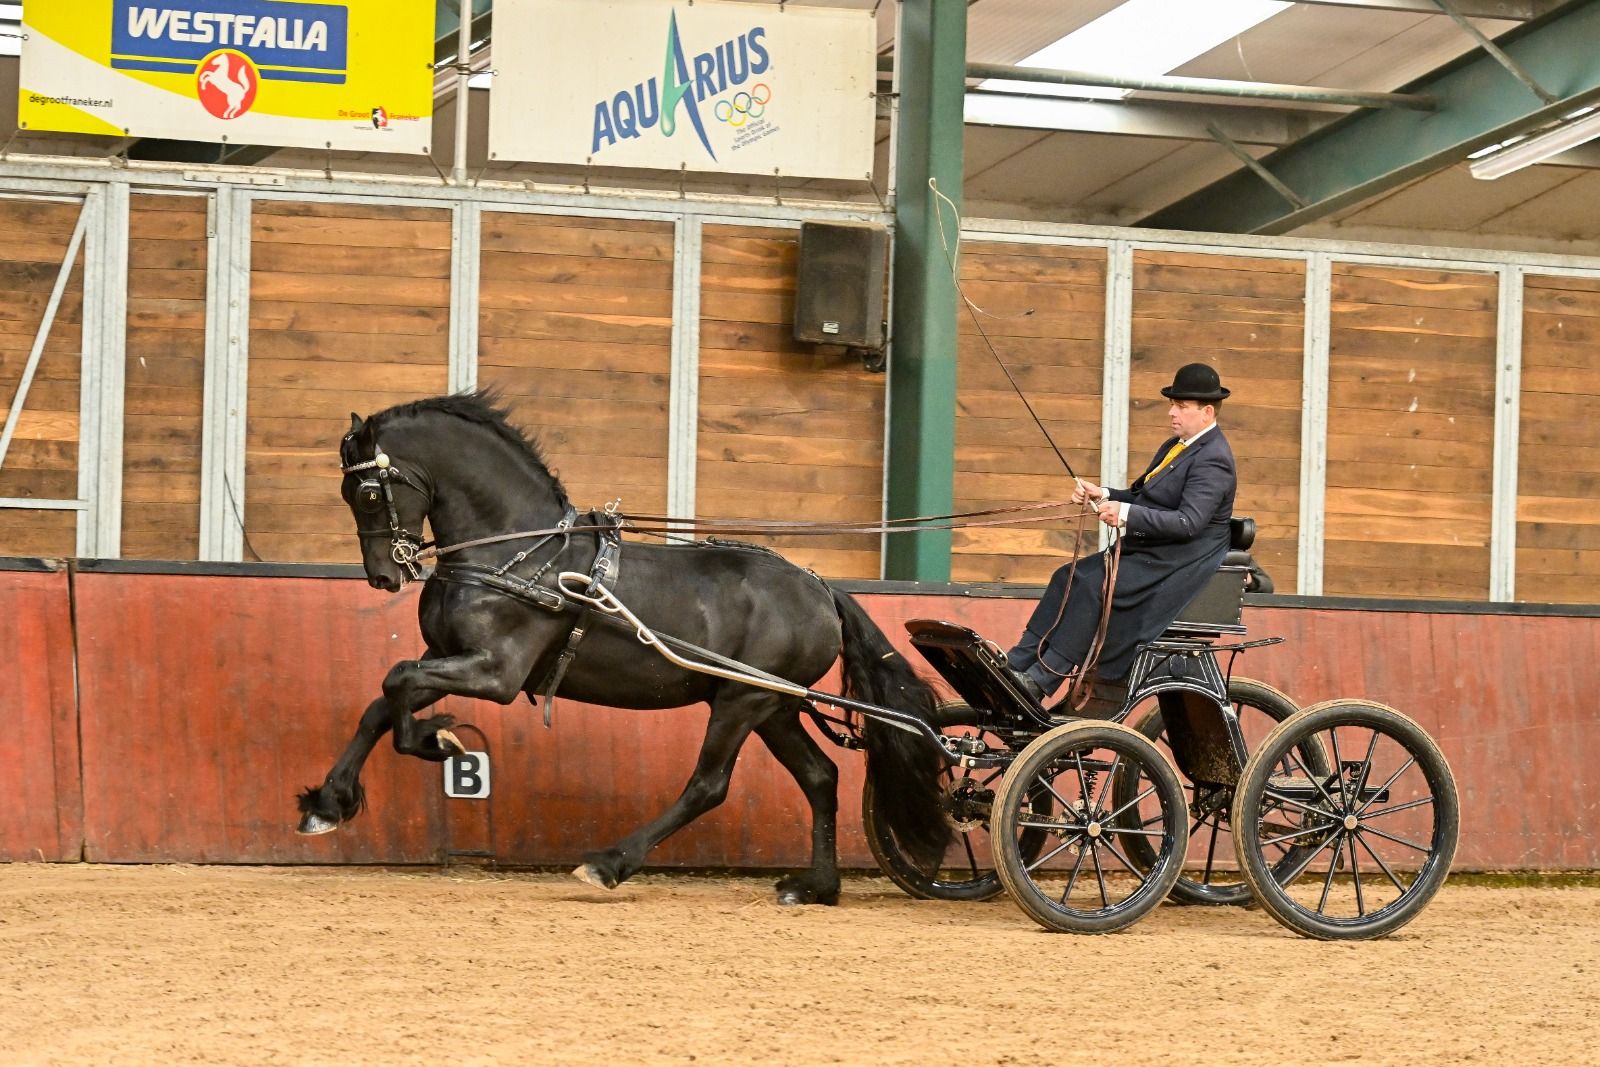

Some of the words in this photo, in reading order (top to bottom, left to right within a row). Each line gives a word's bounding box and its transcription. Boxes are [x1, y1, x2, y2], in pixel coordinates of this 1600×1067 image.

[128, 6, 327, 52] WESTFALIA
[29, 93, 113, 107] degrootfraneker.nl
[591, 7, 769, 163] AQUARIUS
[452, 753, 482, 795] B
